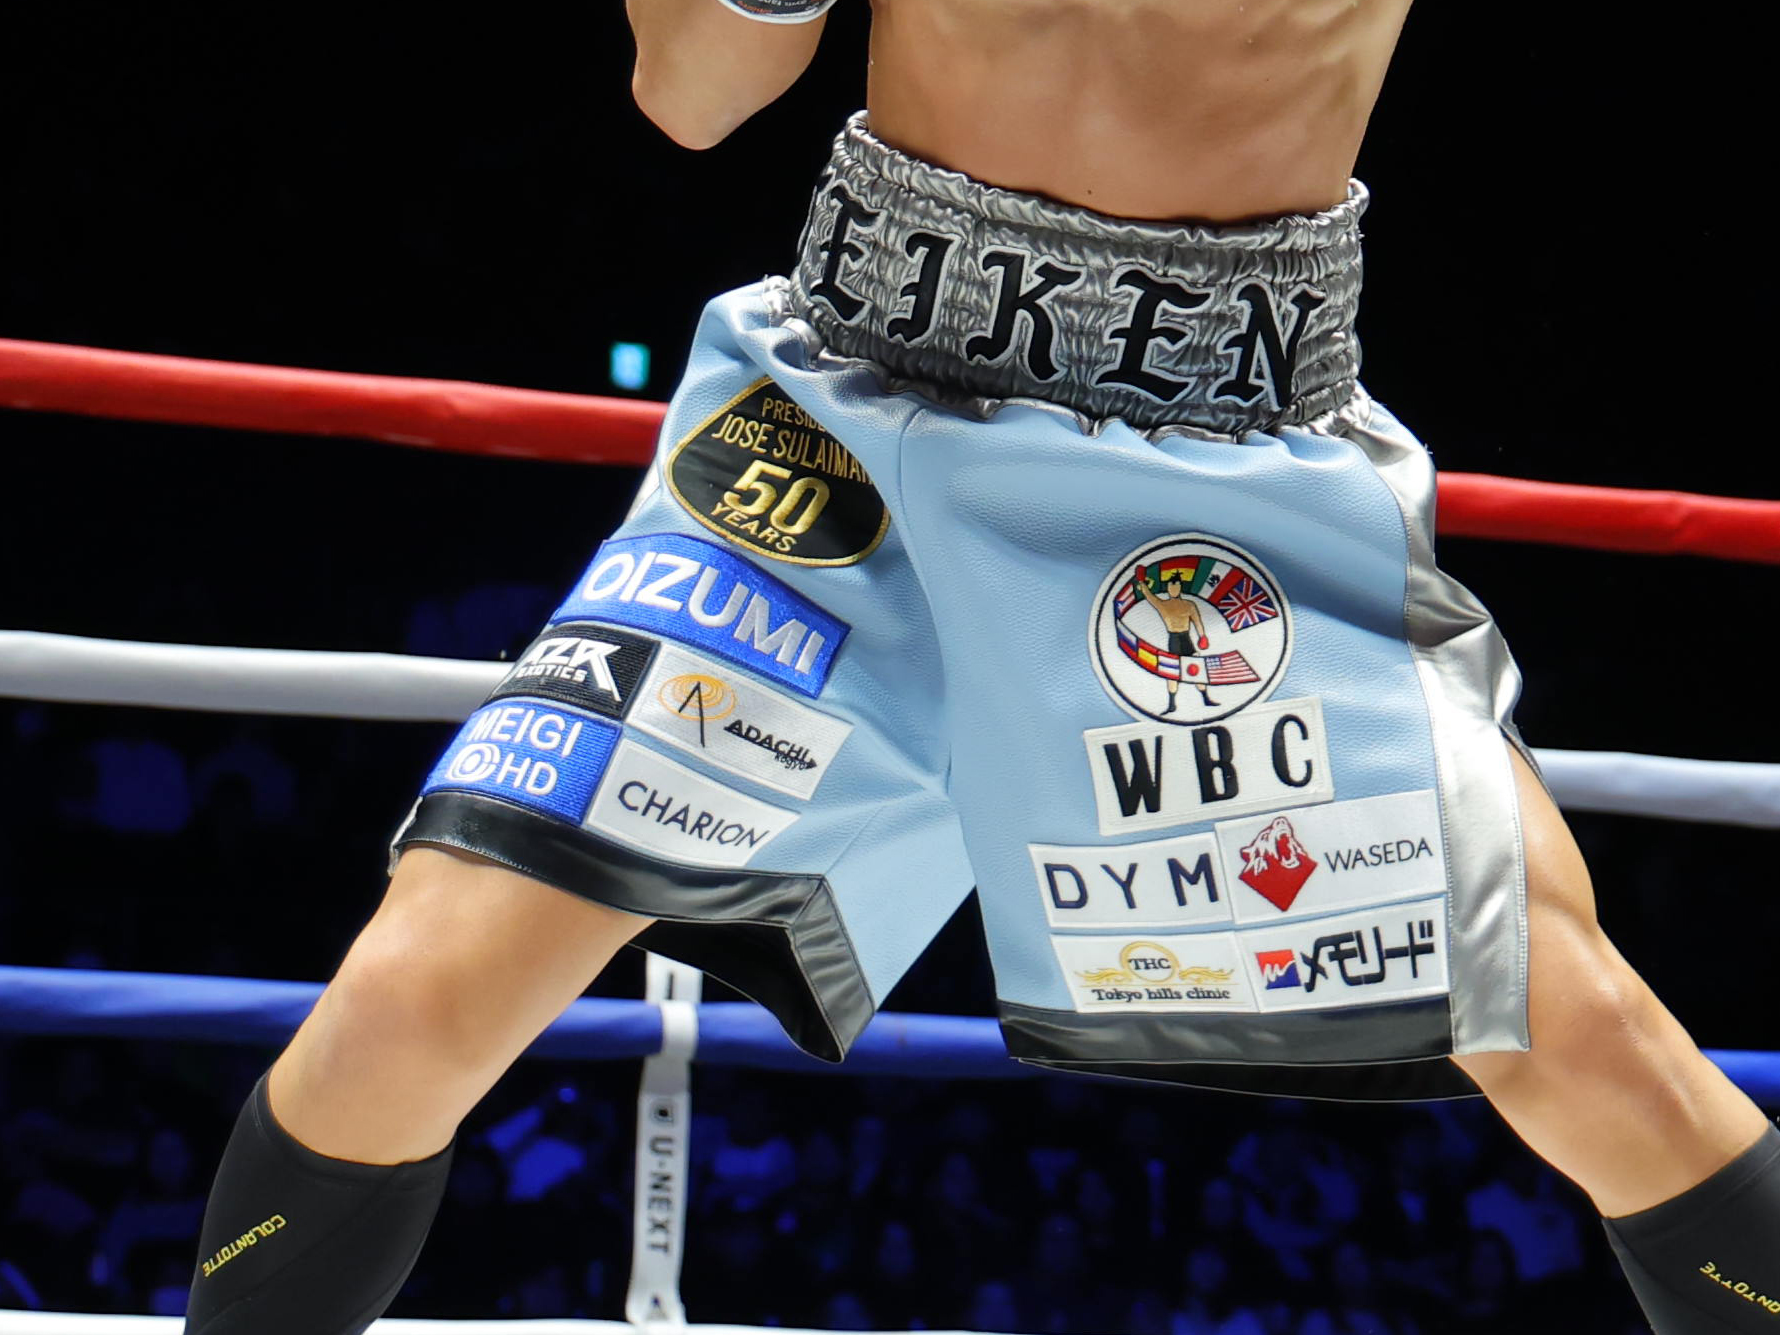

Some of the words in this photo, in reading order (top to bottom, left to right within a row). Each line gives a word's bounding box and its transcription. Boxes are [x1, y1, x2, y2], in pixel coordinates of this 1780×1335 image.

[800, 168, 1326, 410] EIKEN
[711, 414, 775, 454] JOSE
[723, 459, 831, 536] 50
[711, 502, 797, 553] YEARS
[582, 551, 826, 675] OIZUMI
[466, 707, 585, 759] MEIGI
[724, 719, 811, 763] ADACHI
[496, 752, 559, 796] HD
[1104, 714, 1314, 817] WBC
[617, 781, 771, 848] CHARION
[1043, 852, 1219, 910] DYM
[1323, 837, 1434, 874] WASEDA
[1127, 957, 1172, 971] THC
[1300, 919, 1436, 993] メモリード
[1091, 988, 1143, 1003] Tokyo
[1145, 987, 1183, 1000] hills
[1186, 986, 1231, 1000] clinic
[648, 1135, 675, 1254] U-NEXT
[202, 1214, 287, 1278] COLANTOTTE
